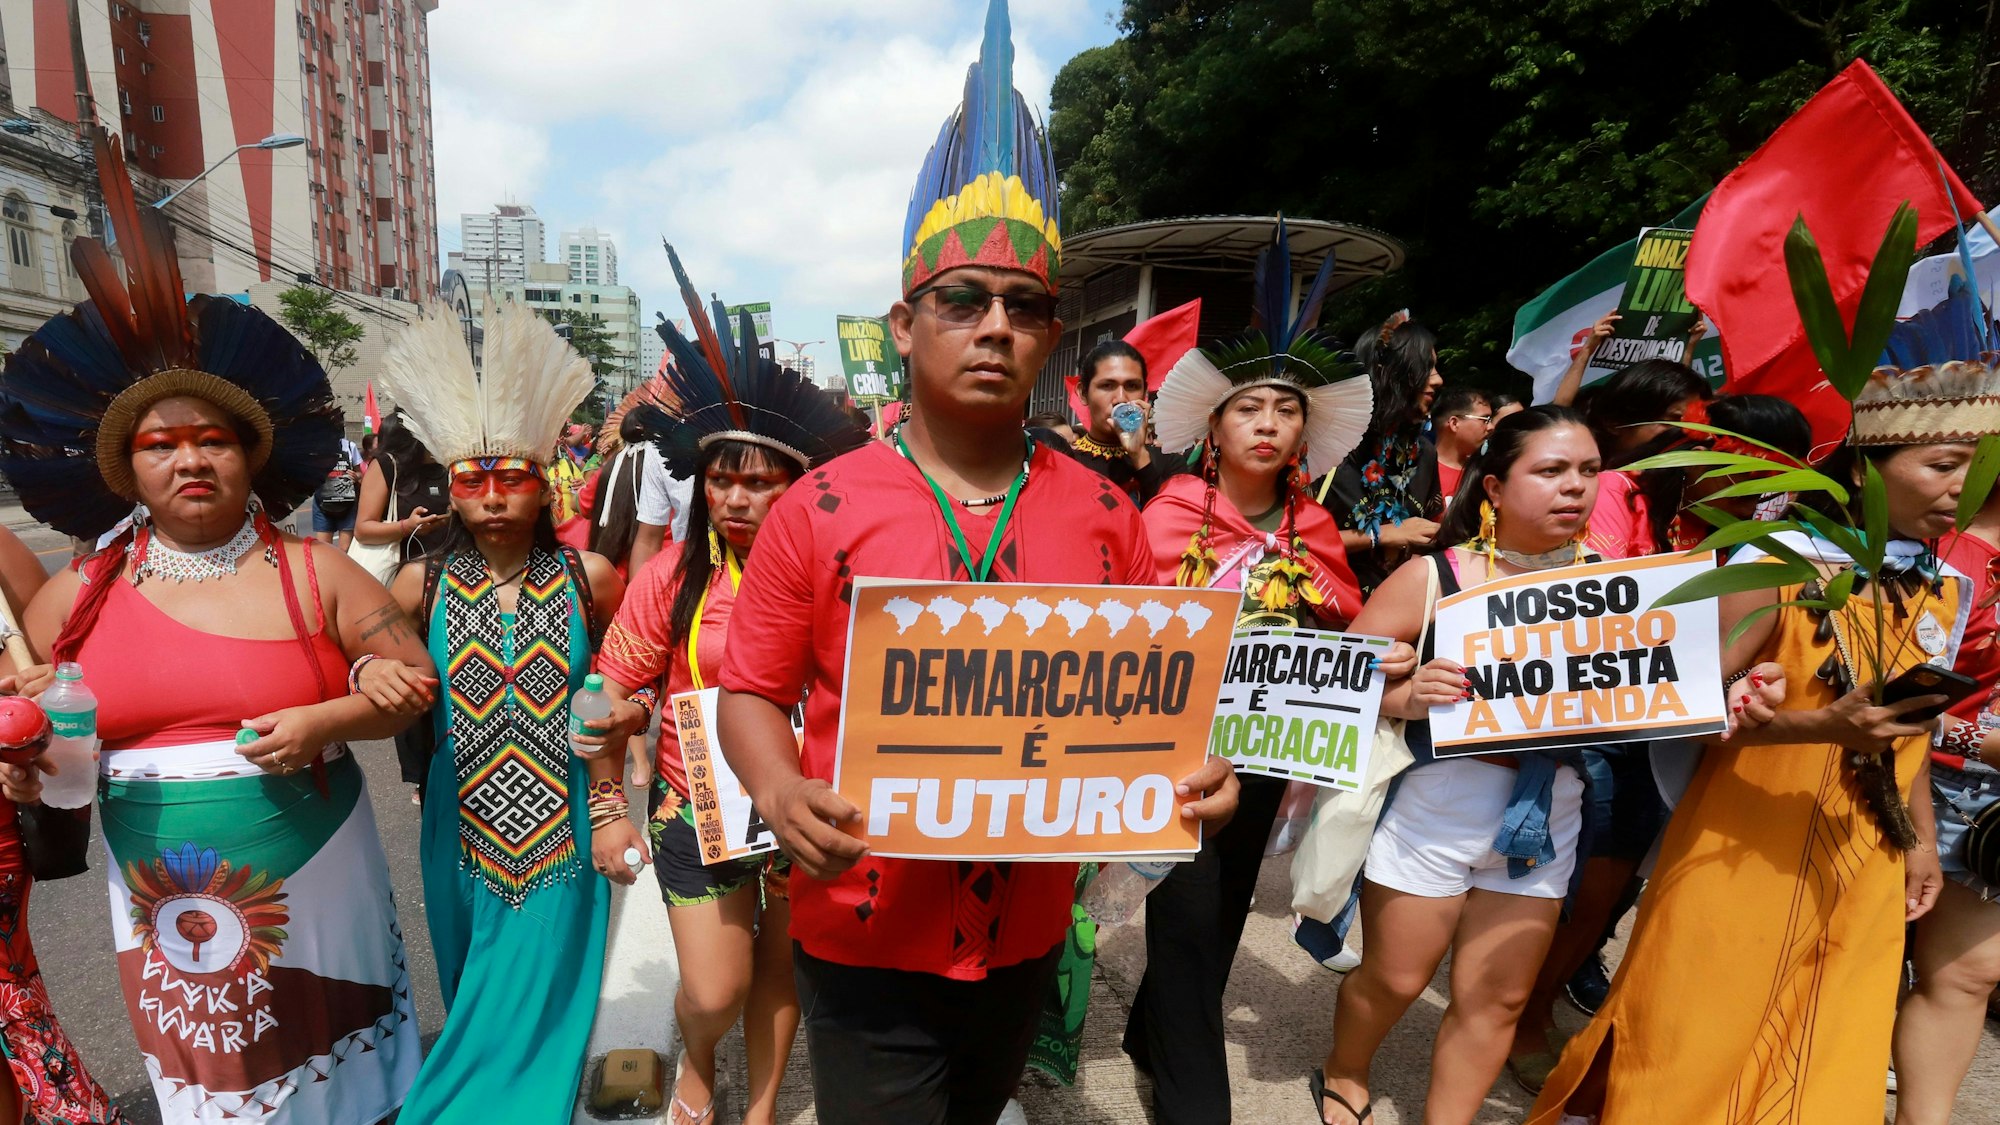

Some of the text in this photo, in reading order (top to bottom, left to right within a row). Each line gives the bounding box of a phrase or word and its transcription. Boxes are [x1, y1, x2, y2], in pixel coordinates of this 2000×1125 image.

[1634, 238, 1692, 269] AMAZ
[1643, 315, 1662, 336] DE
[847, 339, 884, 362] LIVRE
[865, 361, 876, 373] DE
[853, 373, 890, 396] CRIME
[1487, 575, 1639, 629] NOSSO
[1463, 609, 1677, 667] FUTURO
[1223, 643, 1376, 694] ARCAÇÃO
[1467, 639, 1680, 702] NÃO ESTÁ
[880, 644, 1195, 725] DEMARCAÇÃO
[679, 699, 696, 711] PL
[1248, 685, 1269, 712] É
[1513, 682, 1689, 730] VENDA
[679, 709, 699, 720] 2903
[685, 738, 705, 749] MARCO
[690, 731, 698, 739] #
[1021, 724, 1049, 768] É
[1210, 713, 1359, 773] OCRACIA
[684, 745, 708, 756] TEMPORAL
[695, 781, 711, 792] PL
[695, 790, 714, 802] 2903
[705, 812, 713, 820] #
[867, 774, 1174, 839] FUTURO
[699, 826, 723, 837] TEMPORAL
[700, 819, 720, 830] MARCO
